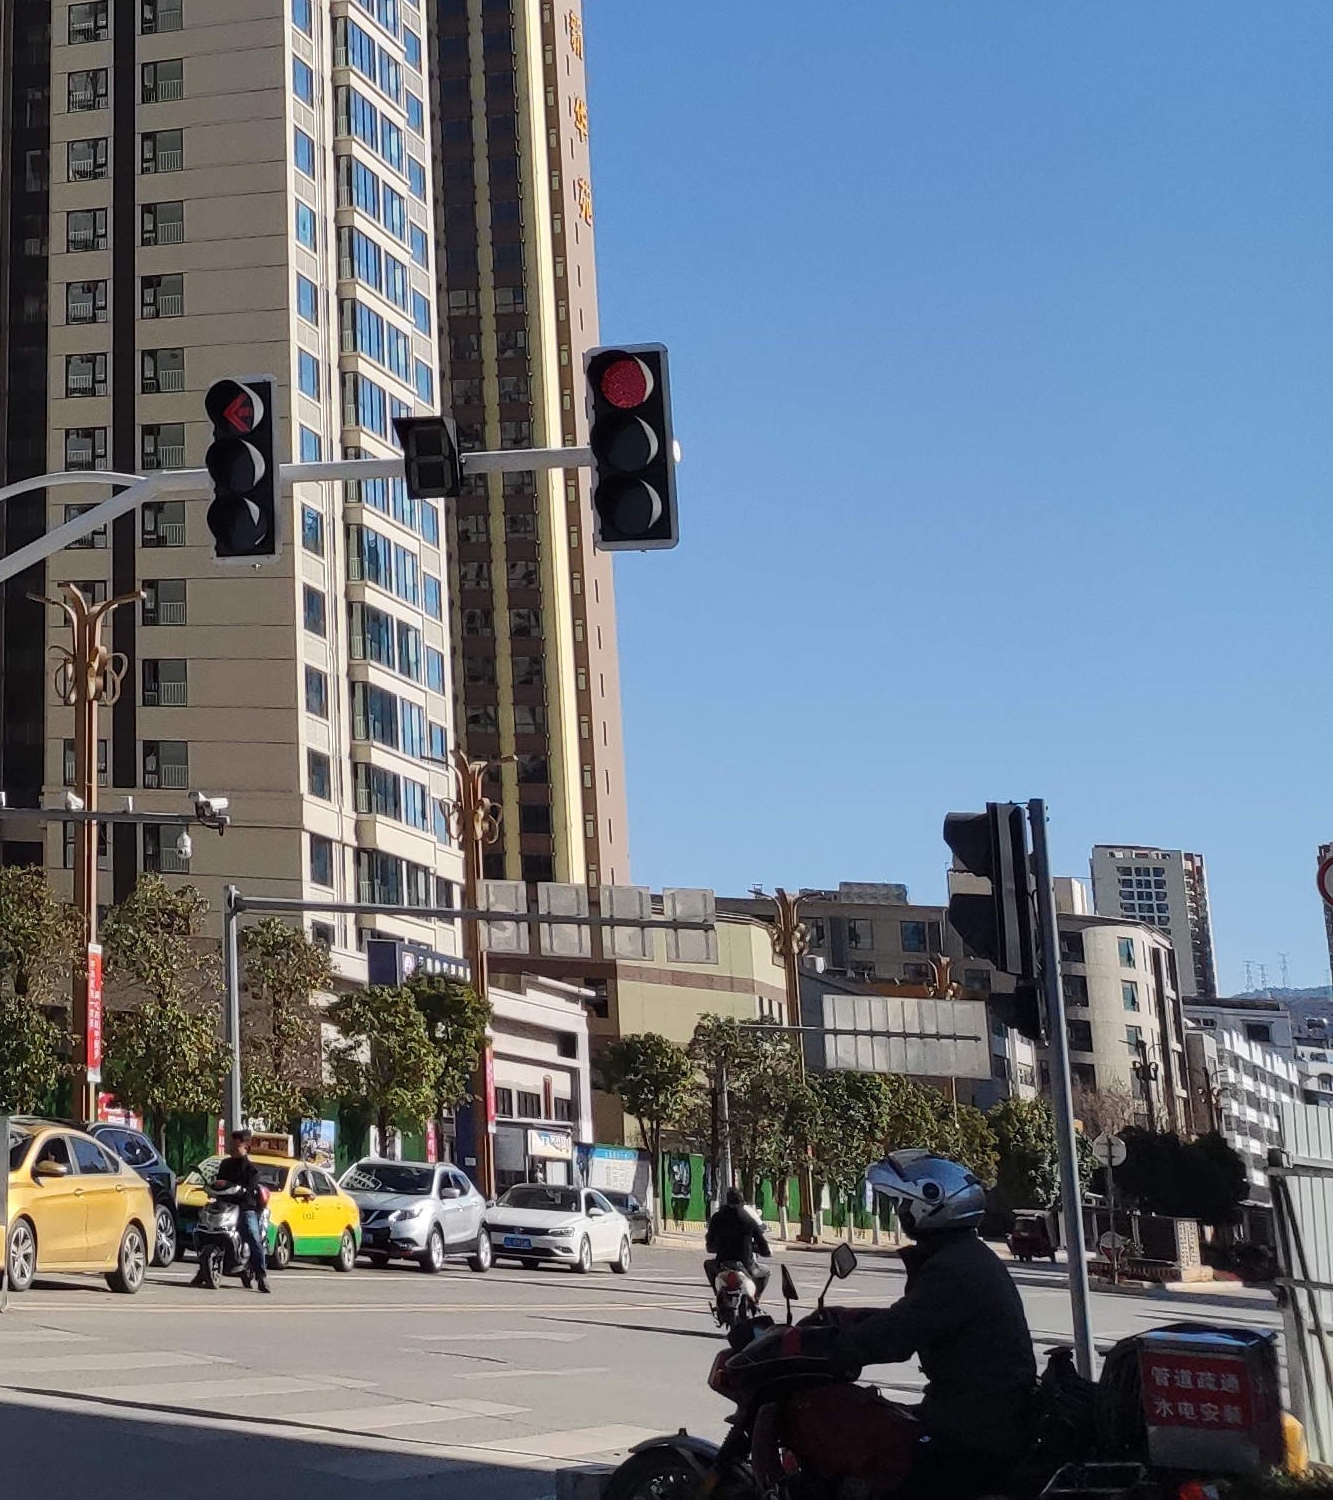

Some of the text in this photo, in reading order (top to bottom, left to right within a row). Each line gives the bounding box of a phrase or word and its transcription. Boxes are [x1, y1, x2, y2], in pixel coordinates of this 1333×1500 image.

[1150, 1365, 1240, 1393] 管道疏通
[1155, 1397, 1242, 1425] 水电安装
